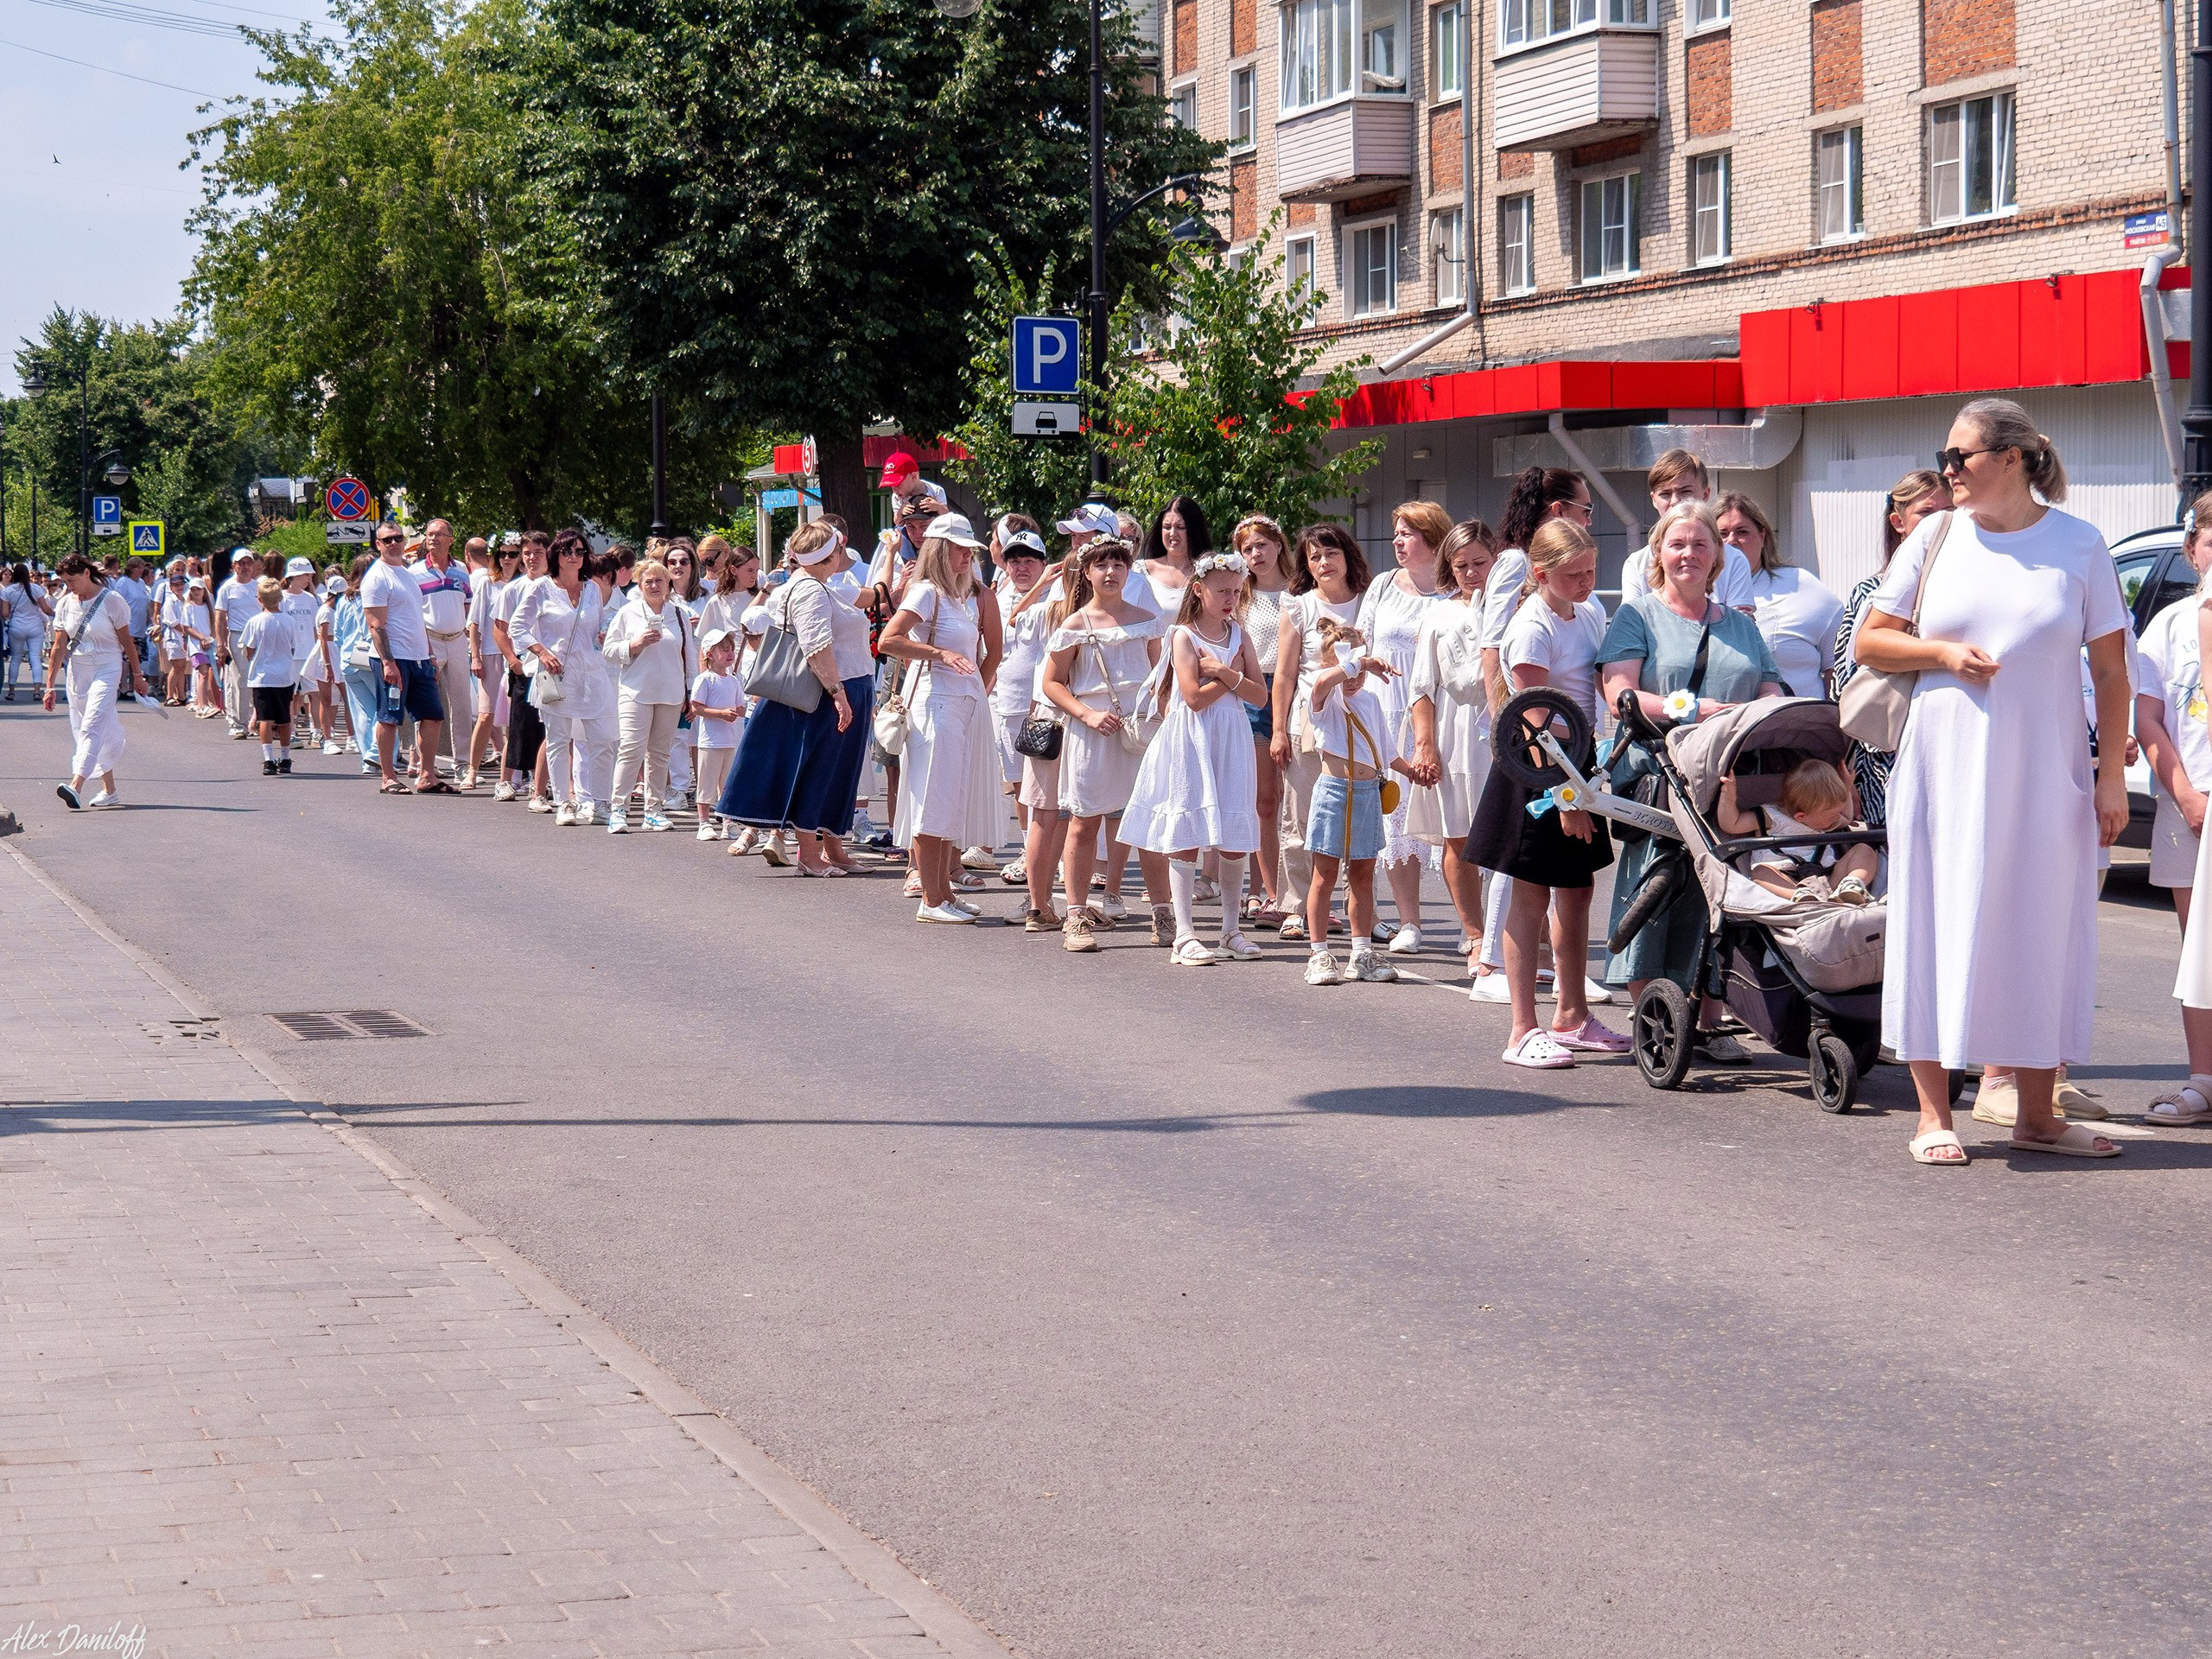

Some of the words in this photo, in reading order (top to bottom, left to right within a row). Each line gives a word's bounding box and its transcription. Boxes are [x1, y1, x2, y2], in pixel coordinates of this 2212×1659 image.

[2158, 219, 2165, 227] 45
[1033, 327, 1066, 383] P
[101, 500, 115, 519] P
[1016, 532, 1027, 541] NY
